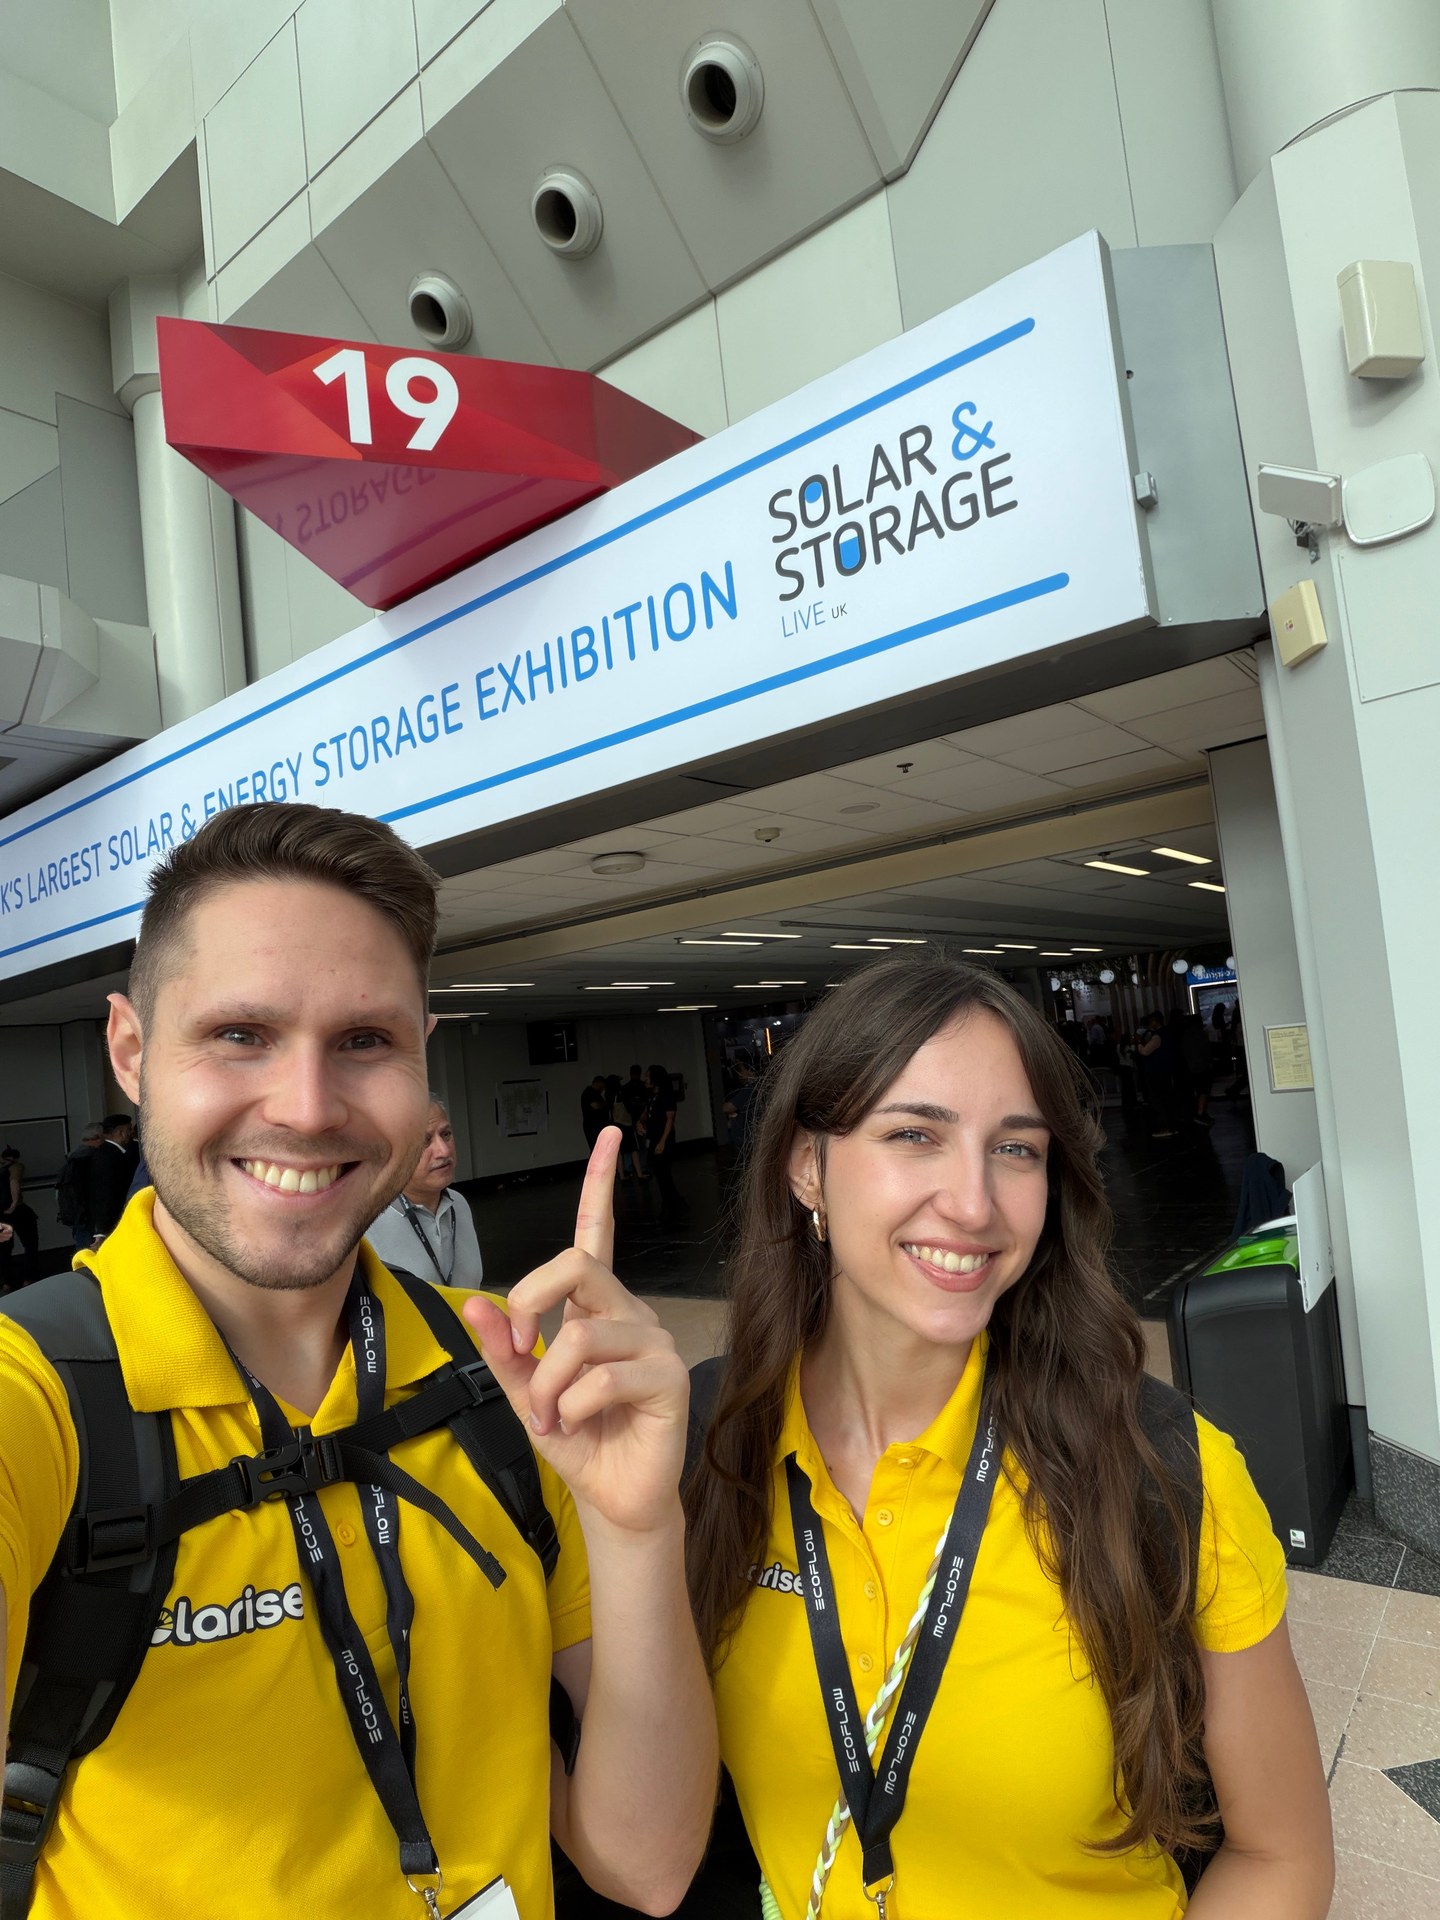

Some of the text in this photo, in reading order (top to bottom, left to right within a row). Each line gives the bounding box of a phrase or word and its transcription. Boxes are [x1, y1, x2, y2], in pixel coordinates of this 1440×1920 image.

[313, 348, 459, 451] 19
[768, 401, 996, 543] SOLAR &
[775, 452, 1018, 602] STORAGE
[781, 600, 848, 638] LIVE UK
[27, 842, 102, 904] LARGEST
[108, 811, 175, 871] SOLAR
[181, 803, 196, 841] &
[312, 682, 463, 787] STORAGE
[475, 560, 738, 721] EXHIBITION
[360, 1296, 377, 1373] ECOFLOW
[803, 1529, 825, 1611] ECOFLOW
[933, 1556, 964, 1638] ECOFLOW
[341, 1650, 383, 1744] ECOFLOW
[832, 1687, 861, 1774] ECOFLOW
[884, 1711, 917, 1795] ECOFLOW
